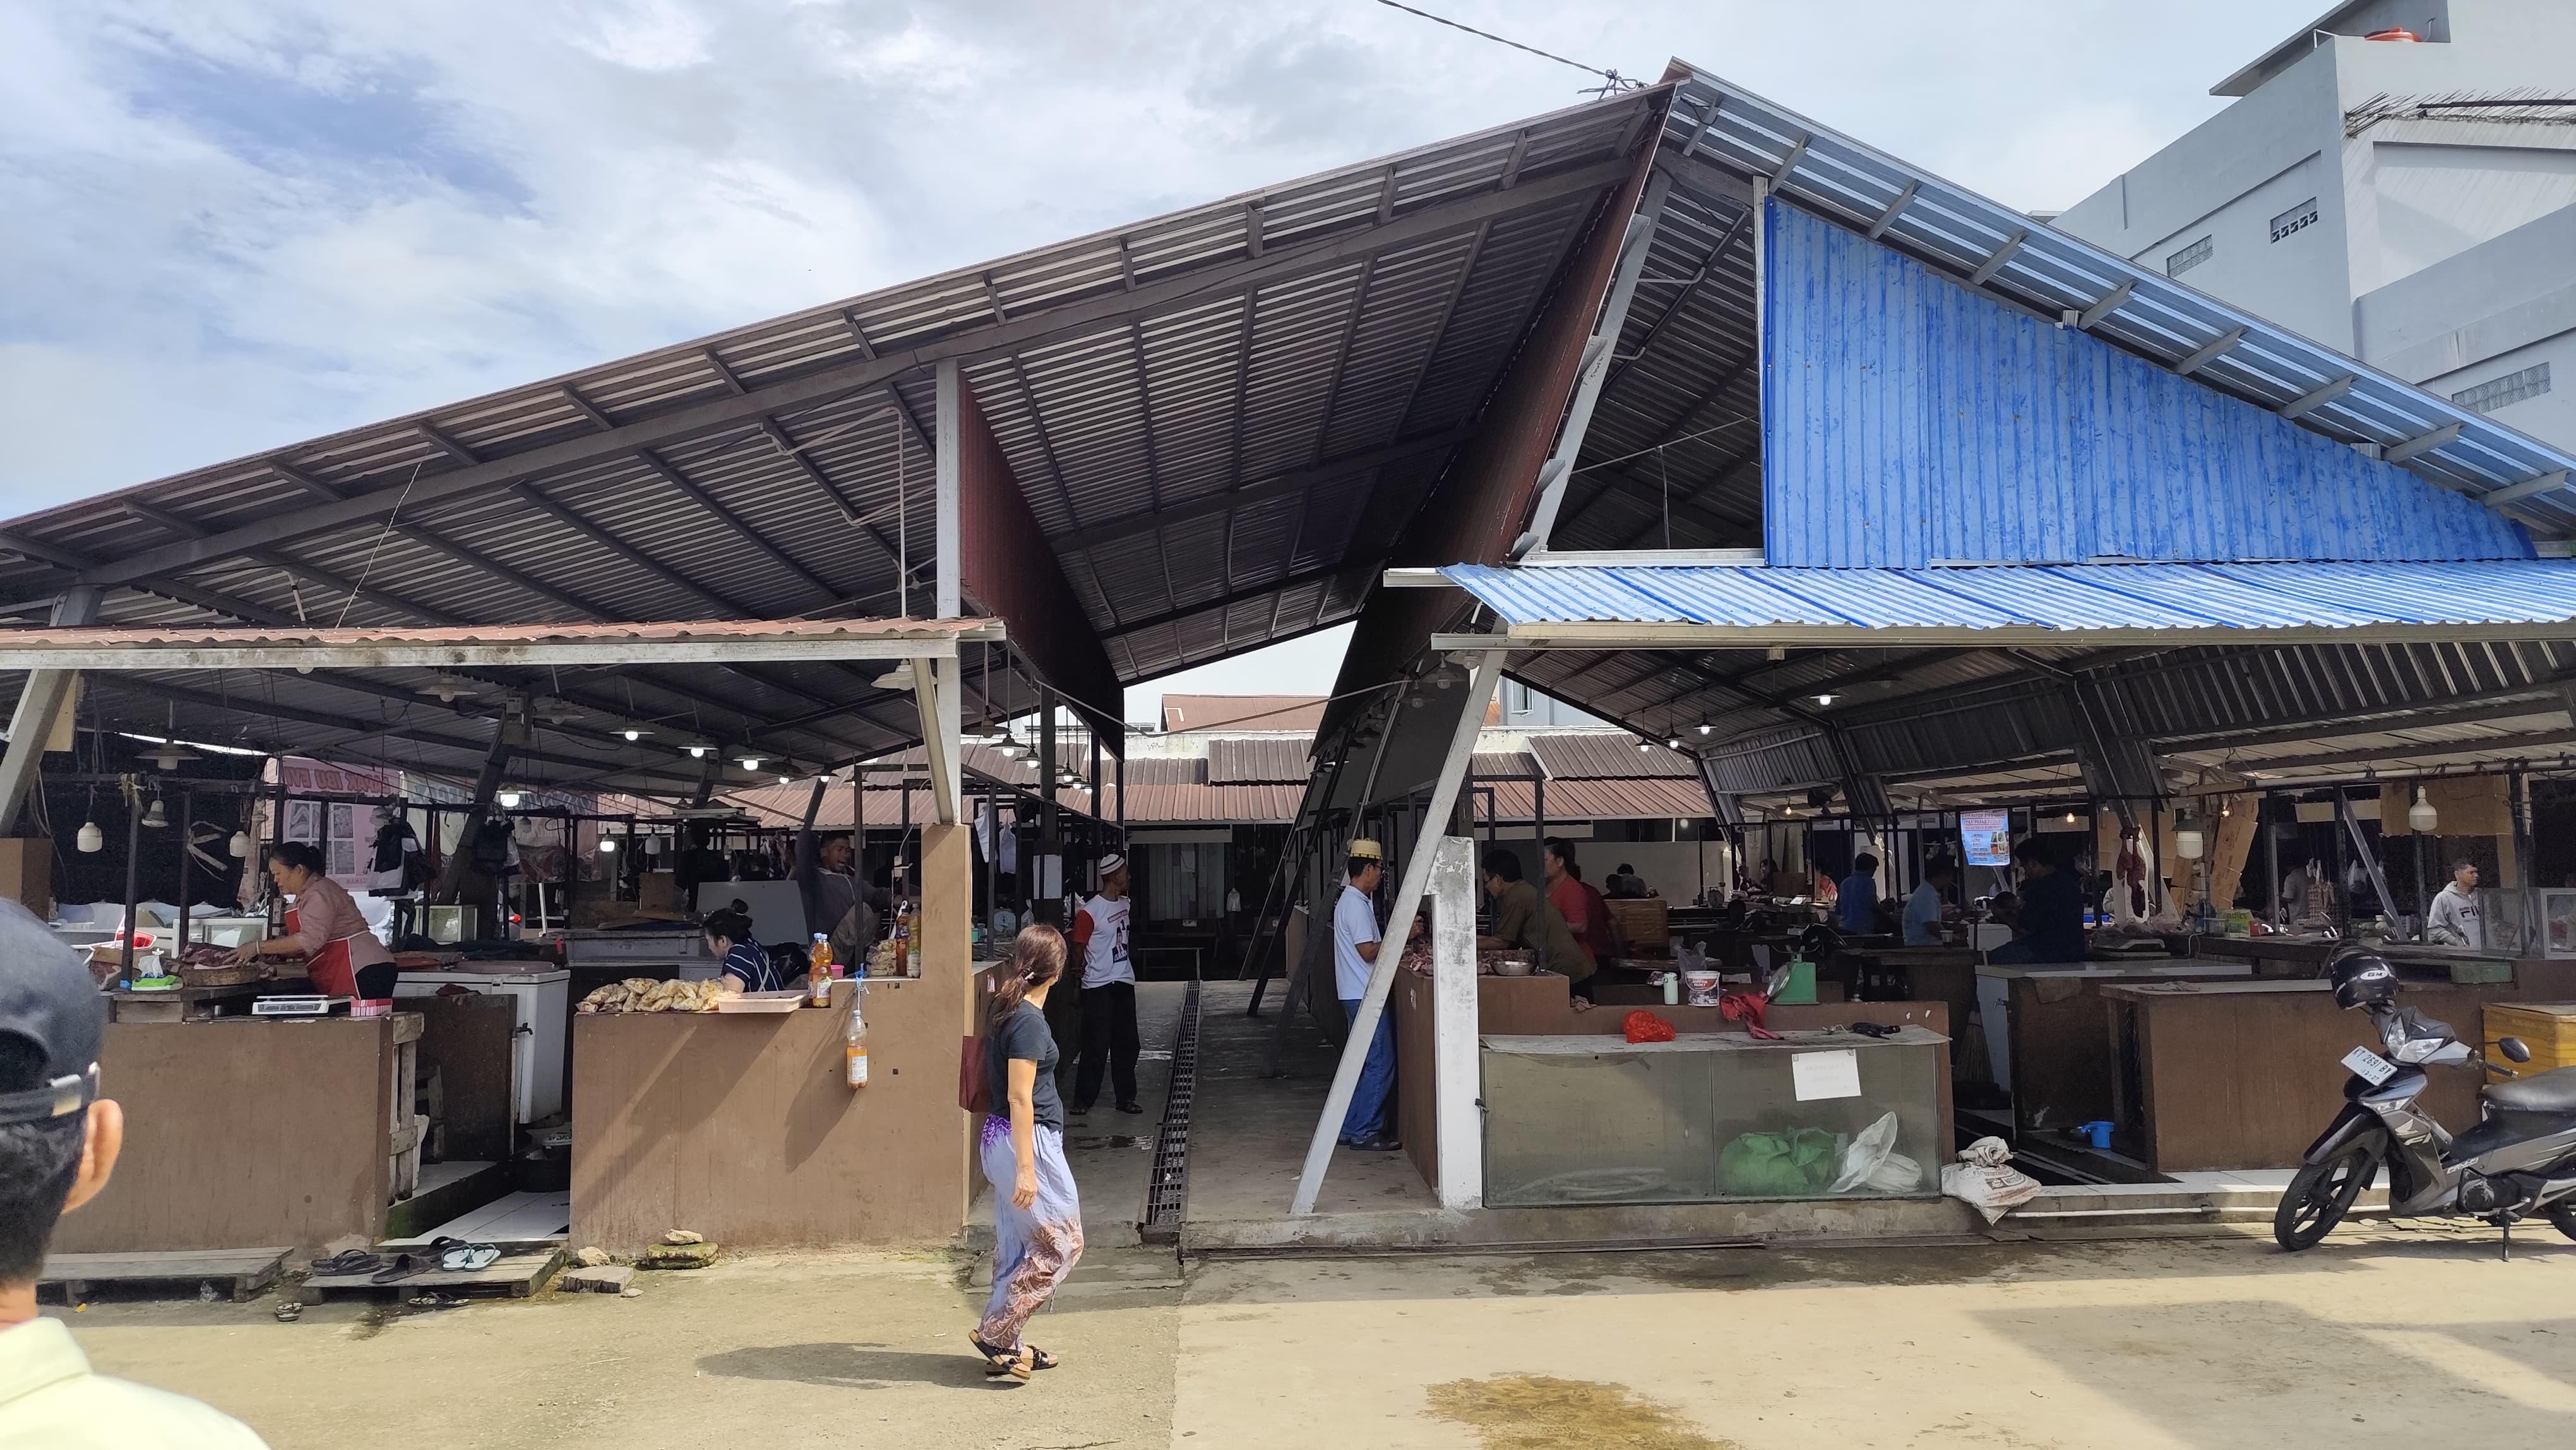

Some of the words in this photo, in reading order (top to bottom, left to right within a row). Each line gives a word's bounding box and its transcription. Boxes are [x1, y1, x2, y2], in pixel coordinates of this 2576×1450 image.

[2352, 1048, 2366, 1058] KT
[2362, 1055, 2382, 1069] 2691
[2378, 1065, 2394, 1075] BY
